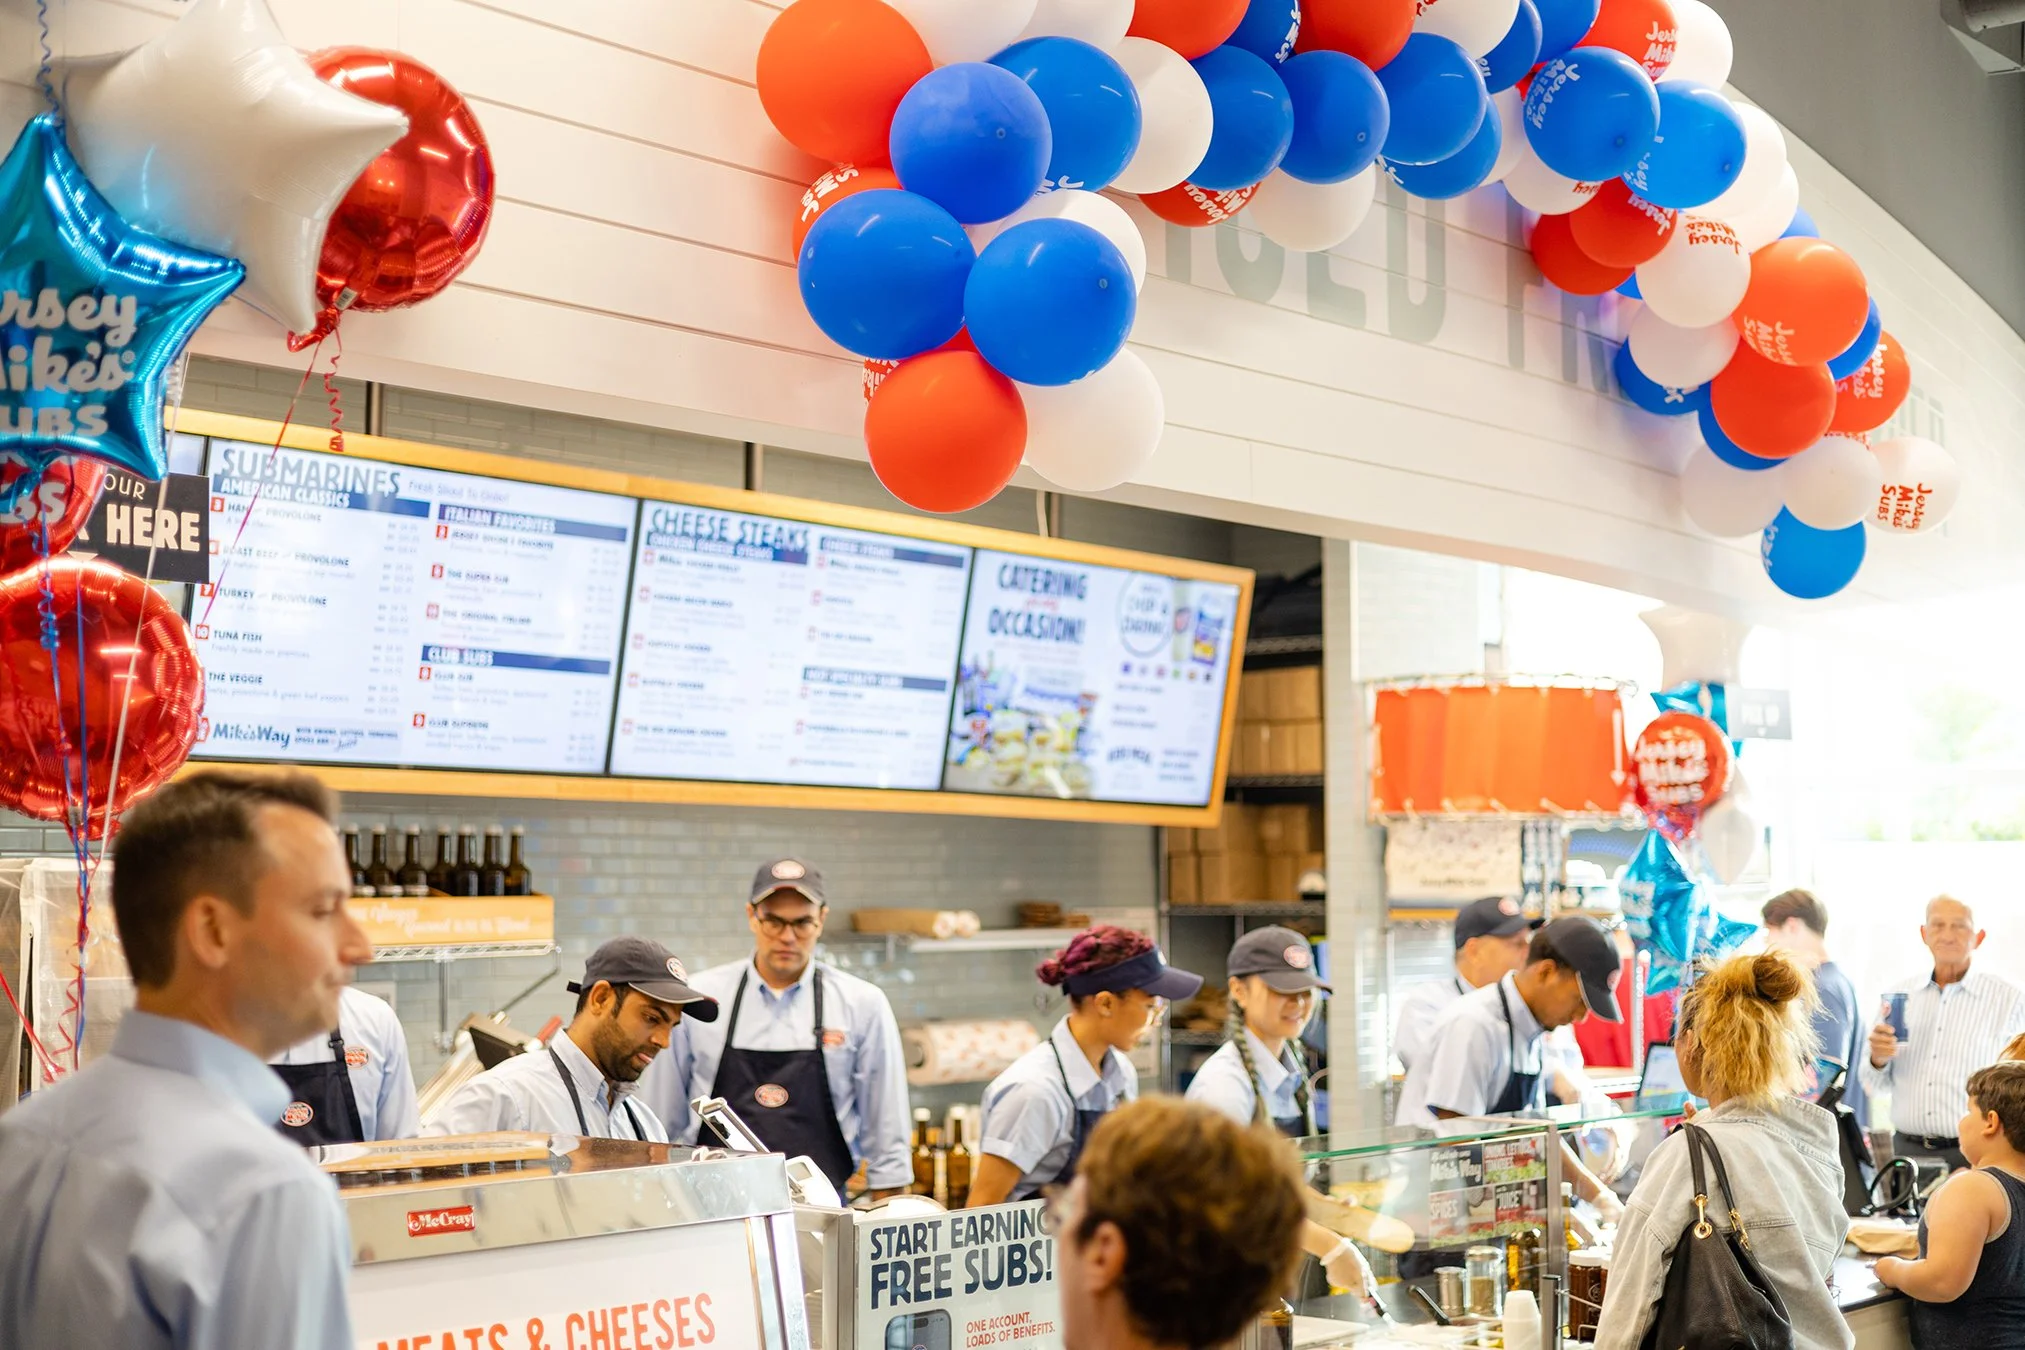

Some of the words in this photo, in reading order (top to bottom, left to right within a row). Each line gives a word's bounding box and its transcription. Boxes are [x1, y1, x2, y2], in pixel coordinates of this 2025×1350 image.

[1532, 64, 1580, 129] Jersey
[0, 336, 134, 393] ike's
[222, 448, 401, 495] SUBMARINES
[220, 477, 292, 501] AMERICAN
[294, 488, 351, 509] CLASSICS
[1906, 483, 1932, 529] Jersey
[106, 503, 201, 552] HERE
[494, 513, 557, 535] FAVORITES
[652, 508, 730, 543] CHEESE
[739, 520, 810, 555] STEAKS
[218, 588, 255, 599] TURKEY
[999, 562, 1088, 600] CATERING
[213, 630, 239, 640] TUNA
[988, 608, 1086, 645] OCCASION!
[428, 645, 461, 664] CLUB
[464, 649, 494, 667] SUBS
[208, 672, 226, 682] THE
[229, 674, 264, 685] VEGGIE
[409, 1211, 474, 1231] McCray
[870, 1220, 943, 1261] START
[871, 1253, 953, 1310] FREE
[964, 1239, 1053, 1294] SUBS!
[565, 1292, 717, 1350] CHEESES
[966, 1321, 987, 1334] ONE
[988, 1311, 1033, 1332] ACCOUNT,
[966, 1333, 997, 1349] LOADS
[998, 1330, 1011, 1342] OF
[1013, 1321, 1056, 1340] BENEFITS.
